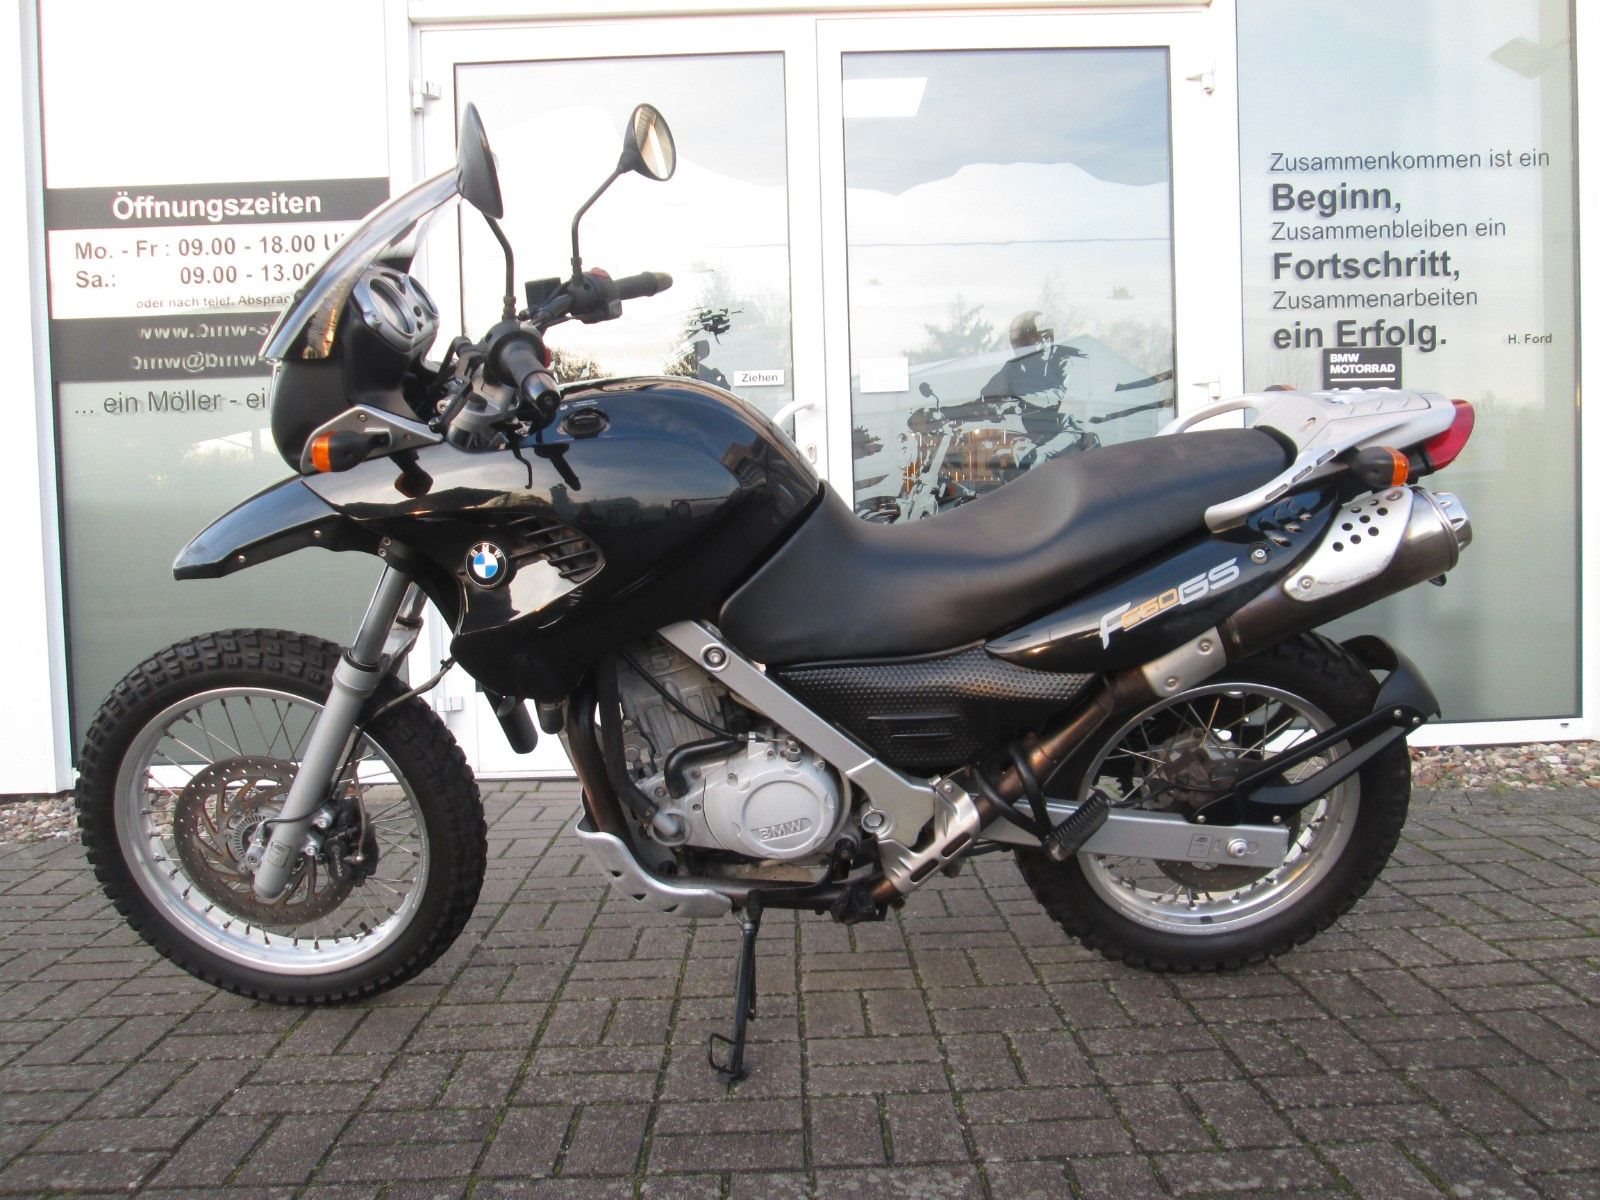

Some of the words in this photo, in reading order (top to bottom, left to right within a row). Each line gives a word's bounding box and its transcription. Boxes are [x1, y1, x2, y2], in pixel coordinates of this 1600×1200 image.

[1270, 150, 1481, 172] Zusammenkommen
[1489, 149, 1512, 168] ist
[1519, 148, 1550, 167] ein
[112, 191, 321, 222] Öffnungszeiten
[1272, 182, 1401, 217] Beginn,
[1271, 219, 1467, 241] Zusammenbleiben
[1475, 218, 1506, 237] ein
[75, 242, 113, 260] Mo.
[178, 238, 236, 257] 09.00
[259, 234, 316, 254] 18.00
[1273, 249, 1460, 281] Fortschritt,
[75, 270, 117, 288] Sa.:
[180, 266, 237, 285] 09.00
[136, 299, 163, 309] oder
[169, 298, 199, 308] nach
[204, 296, 234, 307] telef.
[238, 295, 291, 306] Absprac
[1273, 288, 1478, 310] Zusammenarbeiten
[1273, 321, 1324, 349] ein
[1337, 318, 1447, 352] Erfolg.
[1508, 334, 1521, 345] H.
[1524, 332, 1553, 344] Ford
[1330, 353, 1360, 363] BMW
[1330, 363, 1396, 374] MOTORRAD
[741, 372, 778, 383] Ziehen
[104, 391, 139, 413] ein
[148, 390, 222, 412] Möller
[246, 387, 270, 409] ei
[759, 819, 803, 841] BMW
